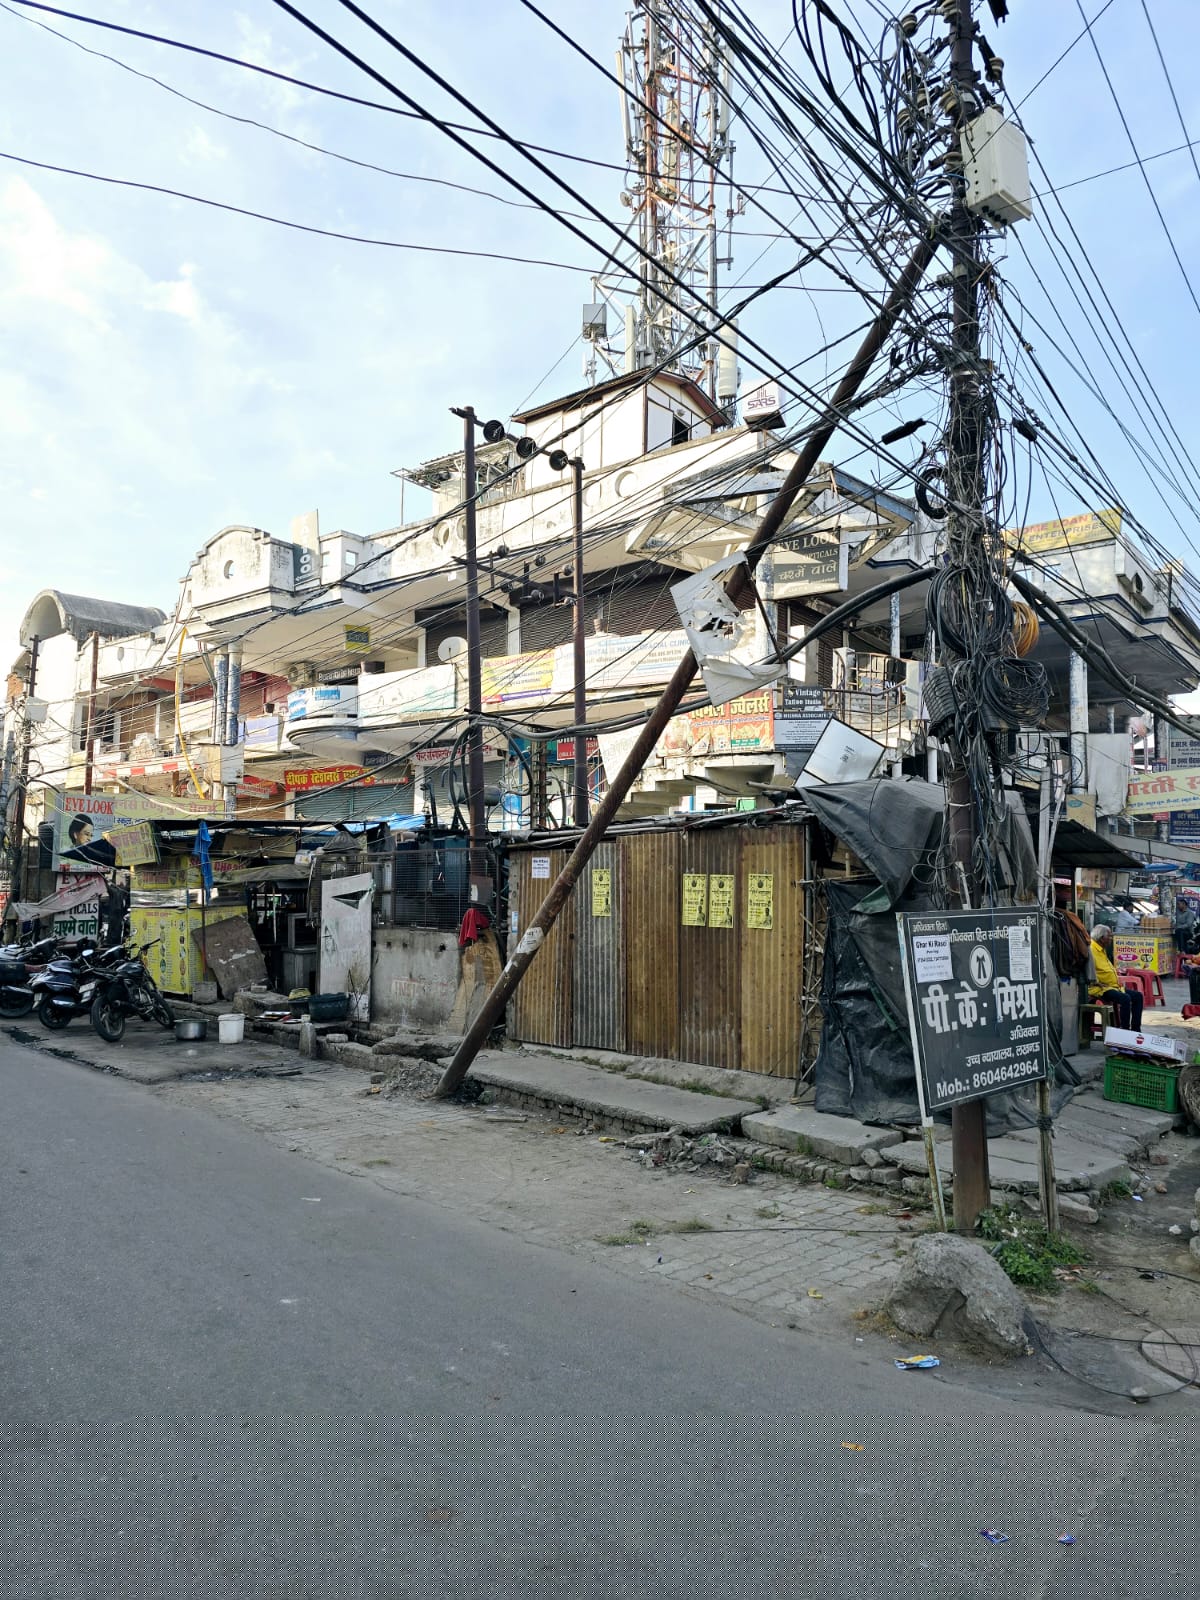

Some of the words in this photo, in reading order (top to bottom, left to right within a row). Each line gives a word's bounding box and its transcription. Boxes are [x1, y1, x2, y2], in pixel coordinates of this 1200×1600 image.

[811, 559, 837, 576] वाले
[795, 687, 821, 698] Vintage
[729, 691, 771, 716] ज्वेलर्स
[286, 772, 308, 786] दीपक
[64, 796, 85, 813] EYE
[86, 799, 114, 815] LOOK
[54, 915, 77, 937] चश्मे
[78, 915, 98, 936] वाले
[975, 927, 988, 942] हित
[992, 976, 1039, 1023] मिश्रा
[1009, 1024, 1040, 1041] अधिवक्ता
[965, 1053, 981, 1068] उच्च
[1015, 1041, 1041, 1057] लखनऊ
[936, 1077, 971, 1099] Mob.:
[972, 1058, 1040, 1089] 8604642964
